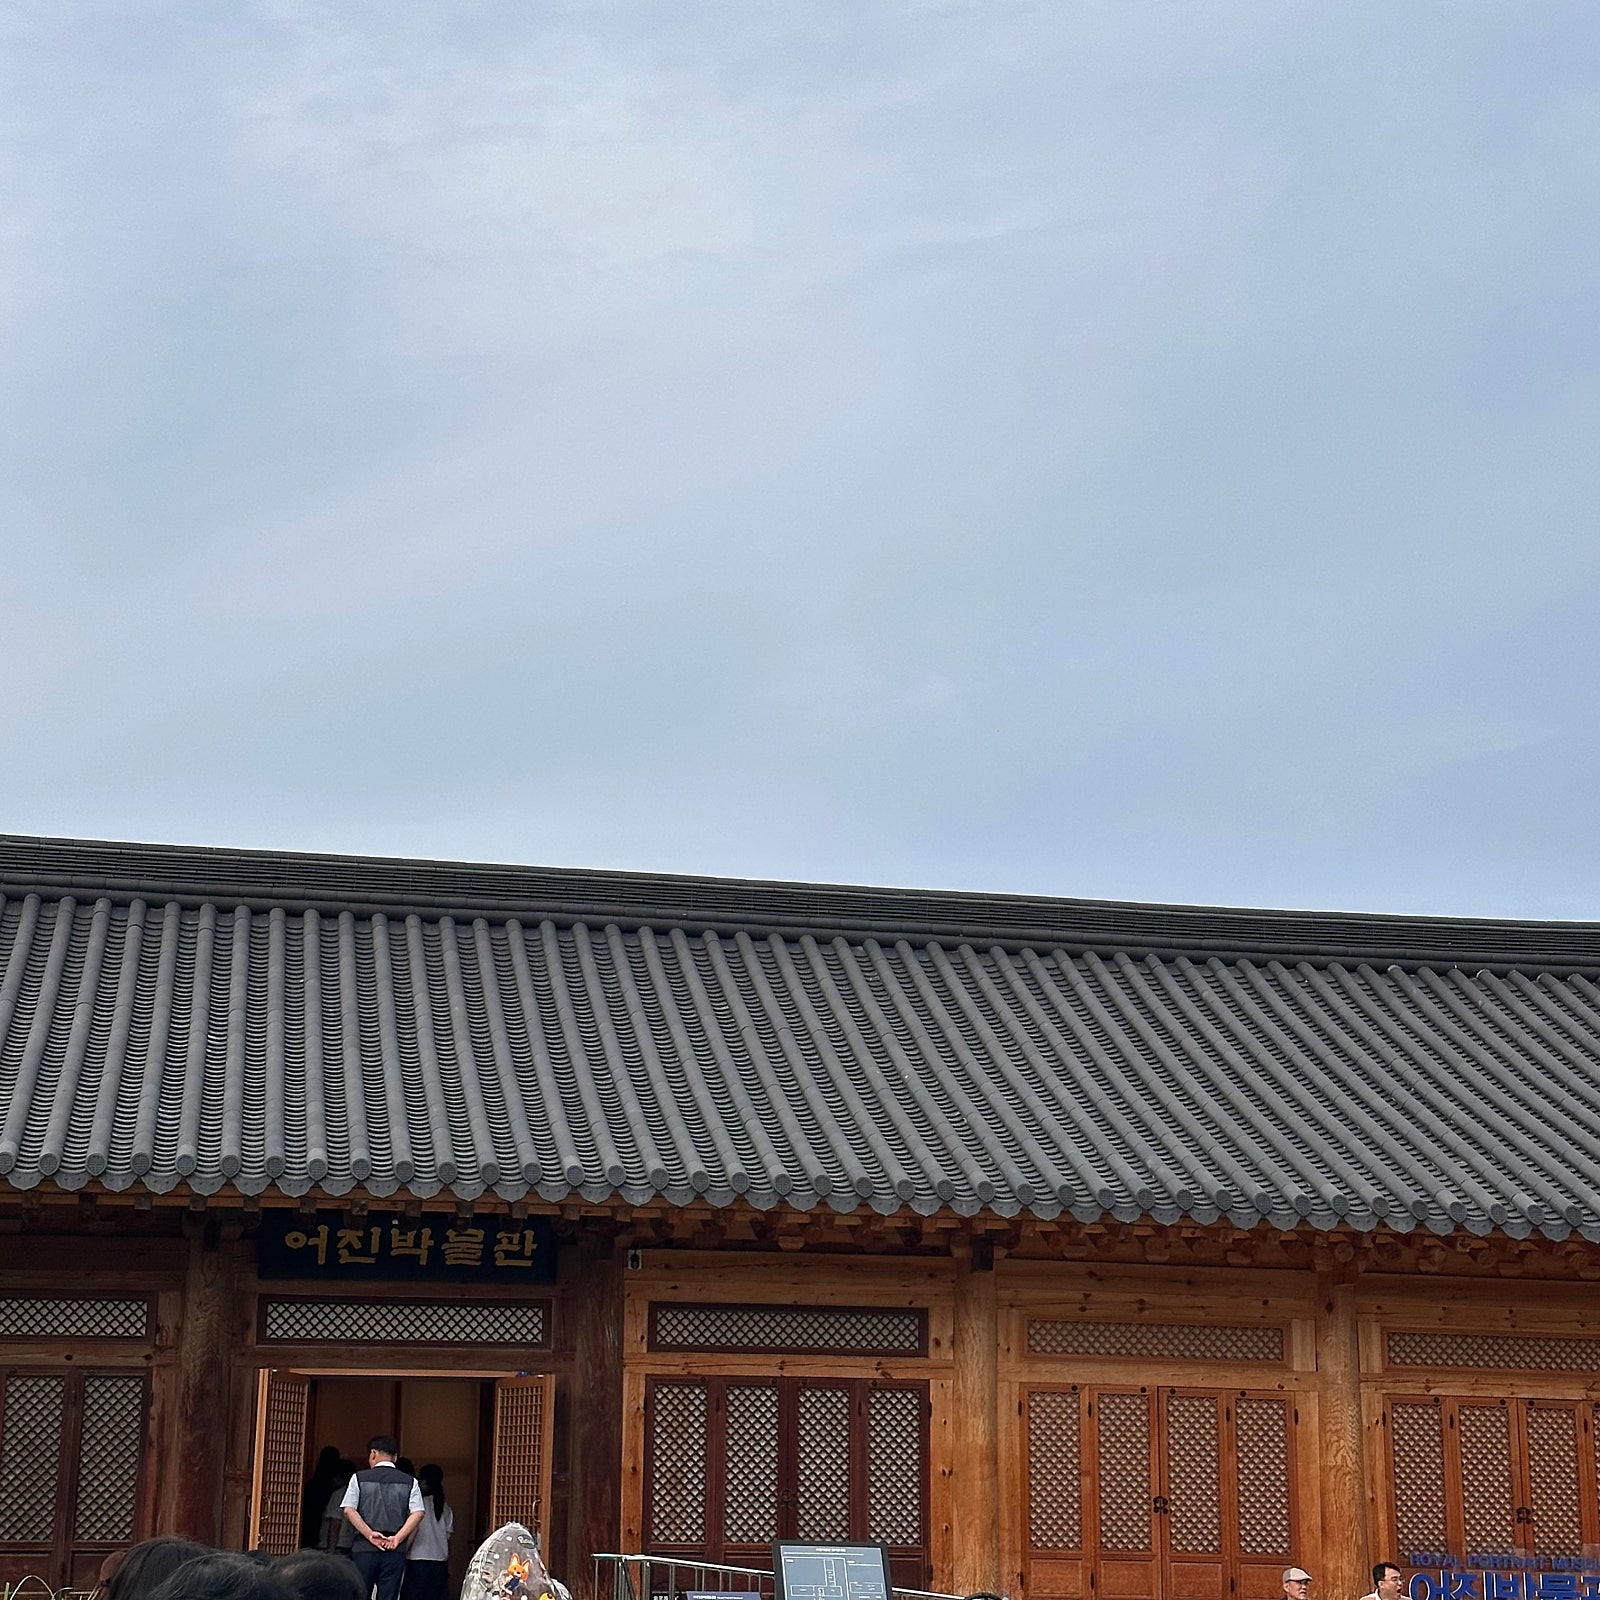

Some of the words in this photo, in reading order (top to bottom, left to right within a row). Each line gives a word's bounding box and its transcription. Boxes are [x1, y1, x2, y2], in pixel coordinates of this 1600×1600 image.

[284, 1224, 537, 1267] 어진박물관
[1411, 1553, 1460, 1569] ROYAL
[1468, 1555, 1545, 1571] PORTRAIT
